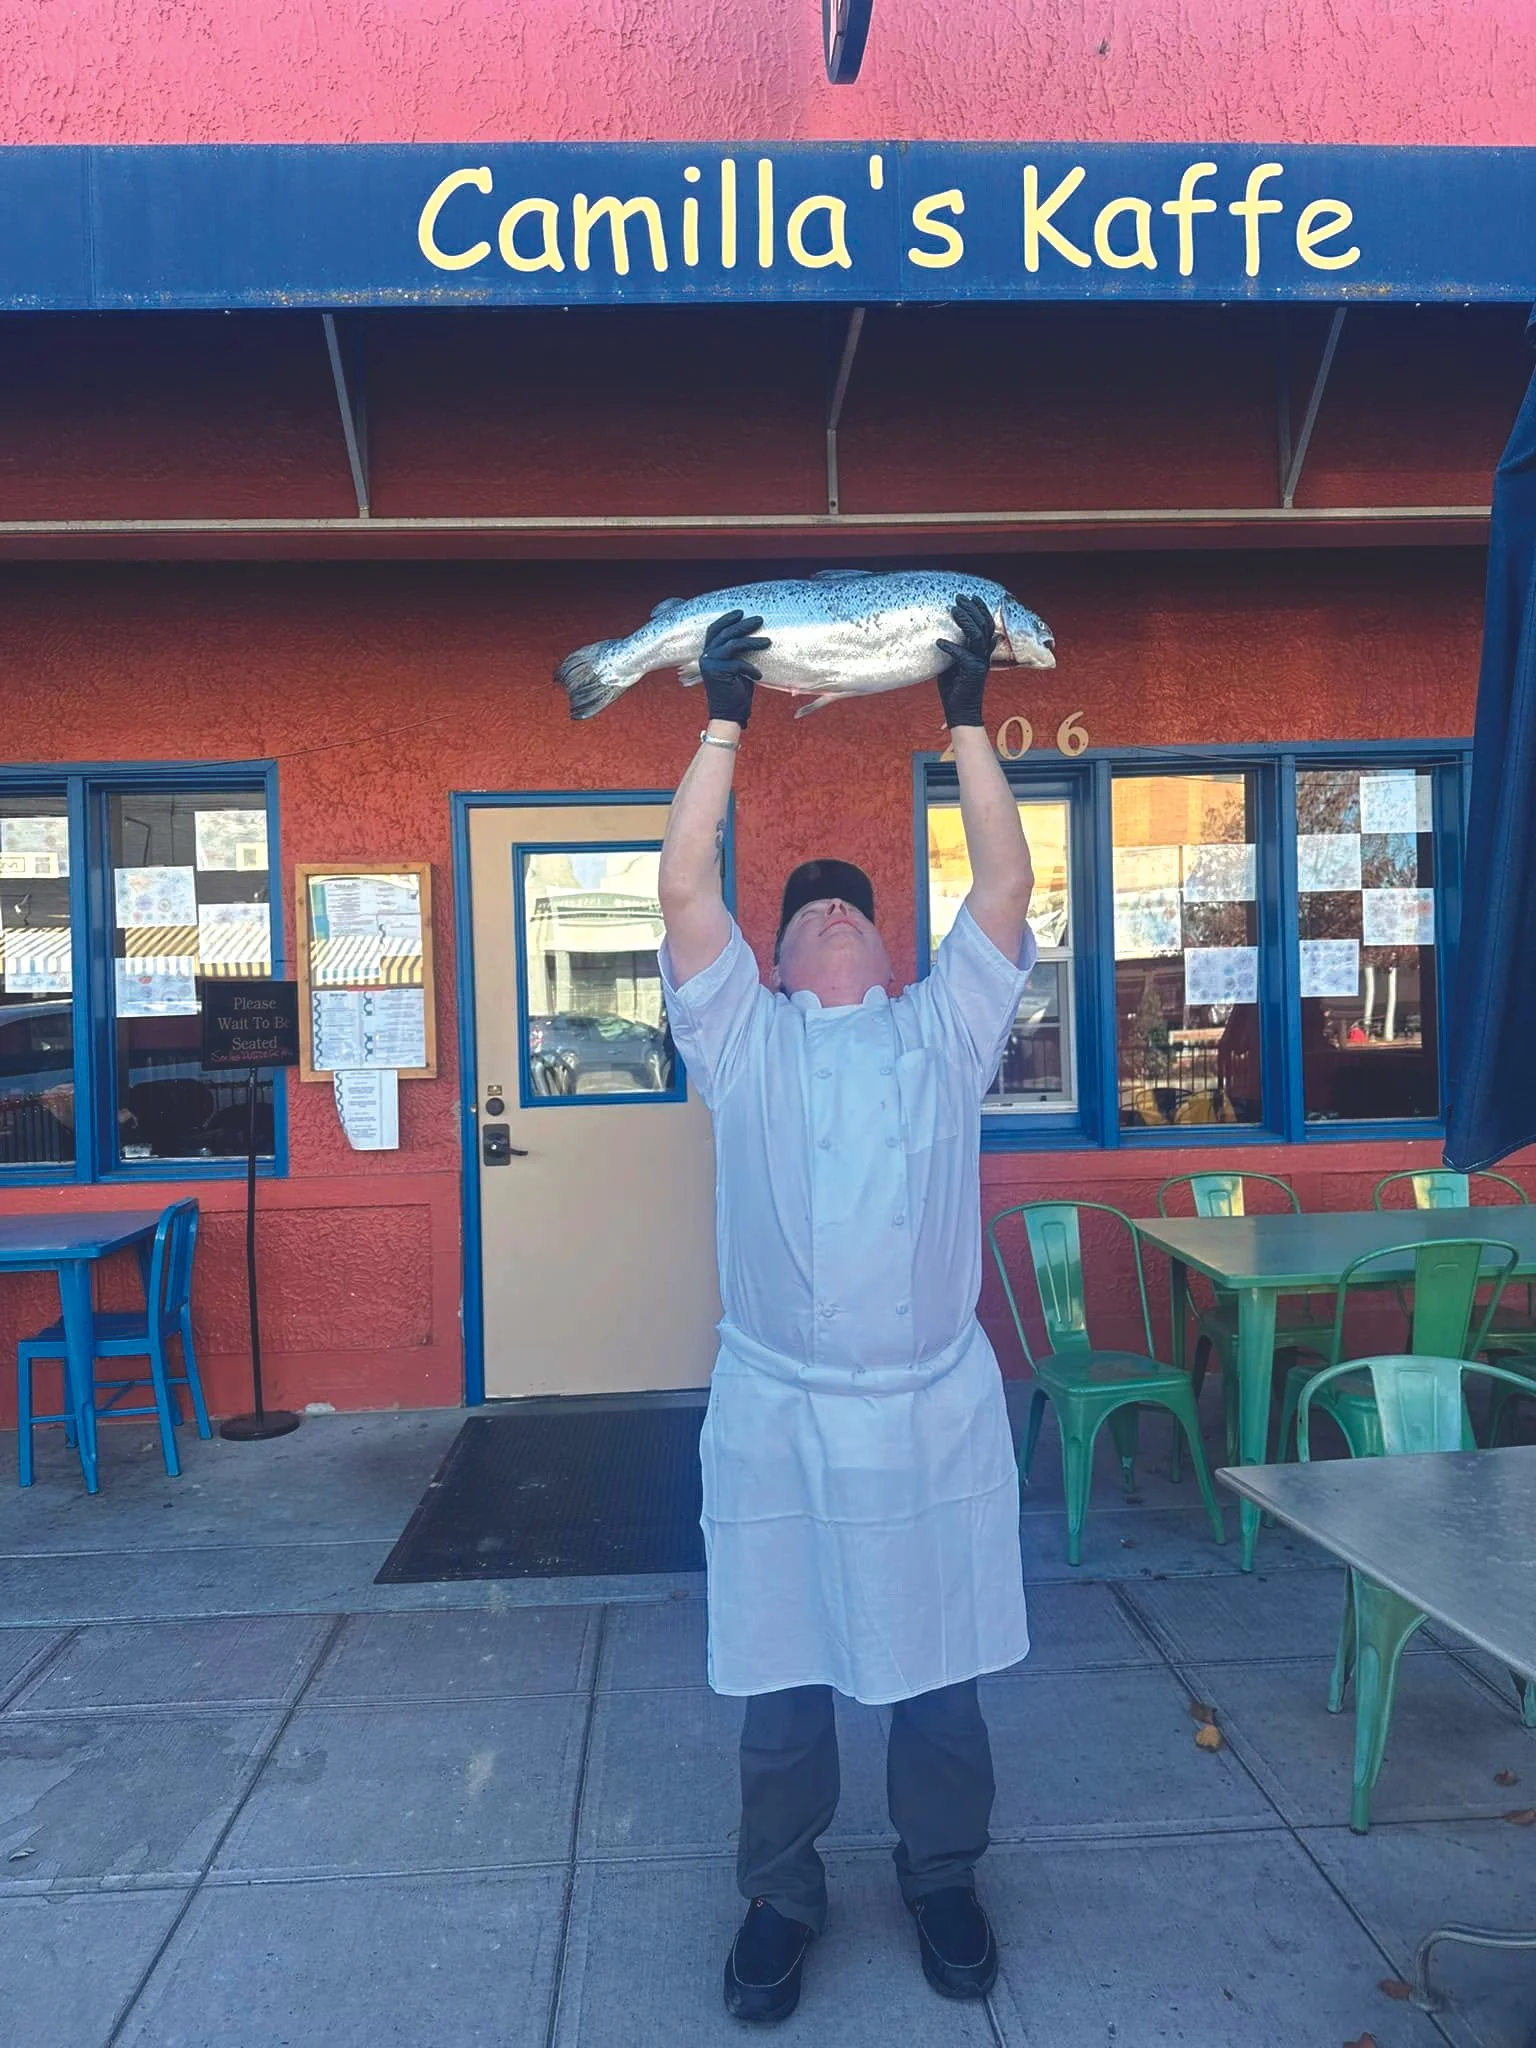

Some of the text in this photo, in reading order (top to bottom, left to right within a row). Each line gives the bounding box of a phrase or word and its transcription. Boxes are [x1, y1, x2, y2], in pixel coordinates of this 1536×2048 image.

[418, 156, 1361, 277] Camilla's Kaffe
[940, 711, 1089, 762] 06
[233, 996, 277, 1010] Please
[217, 1015, 289, 1030] Wait To Be
[232, 1036, 278, 1050] Seated
